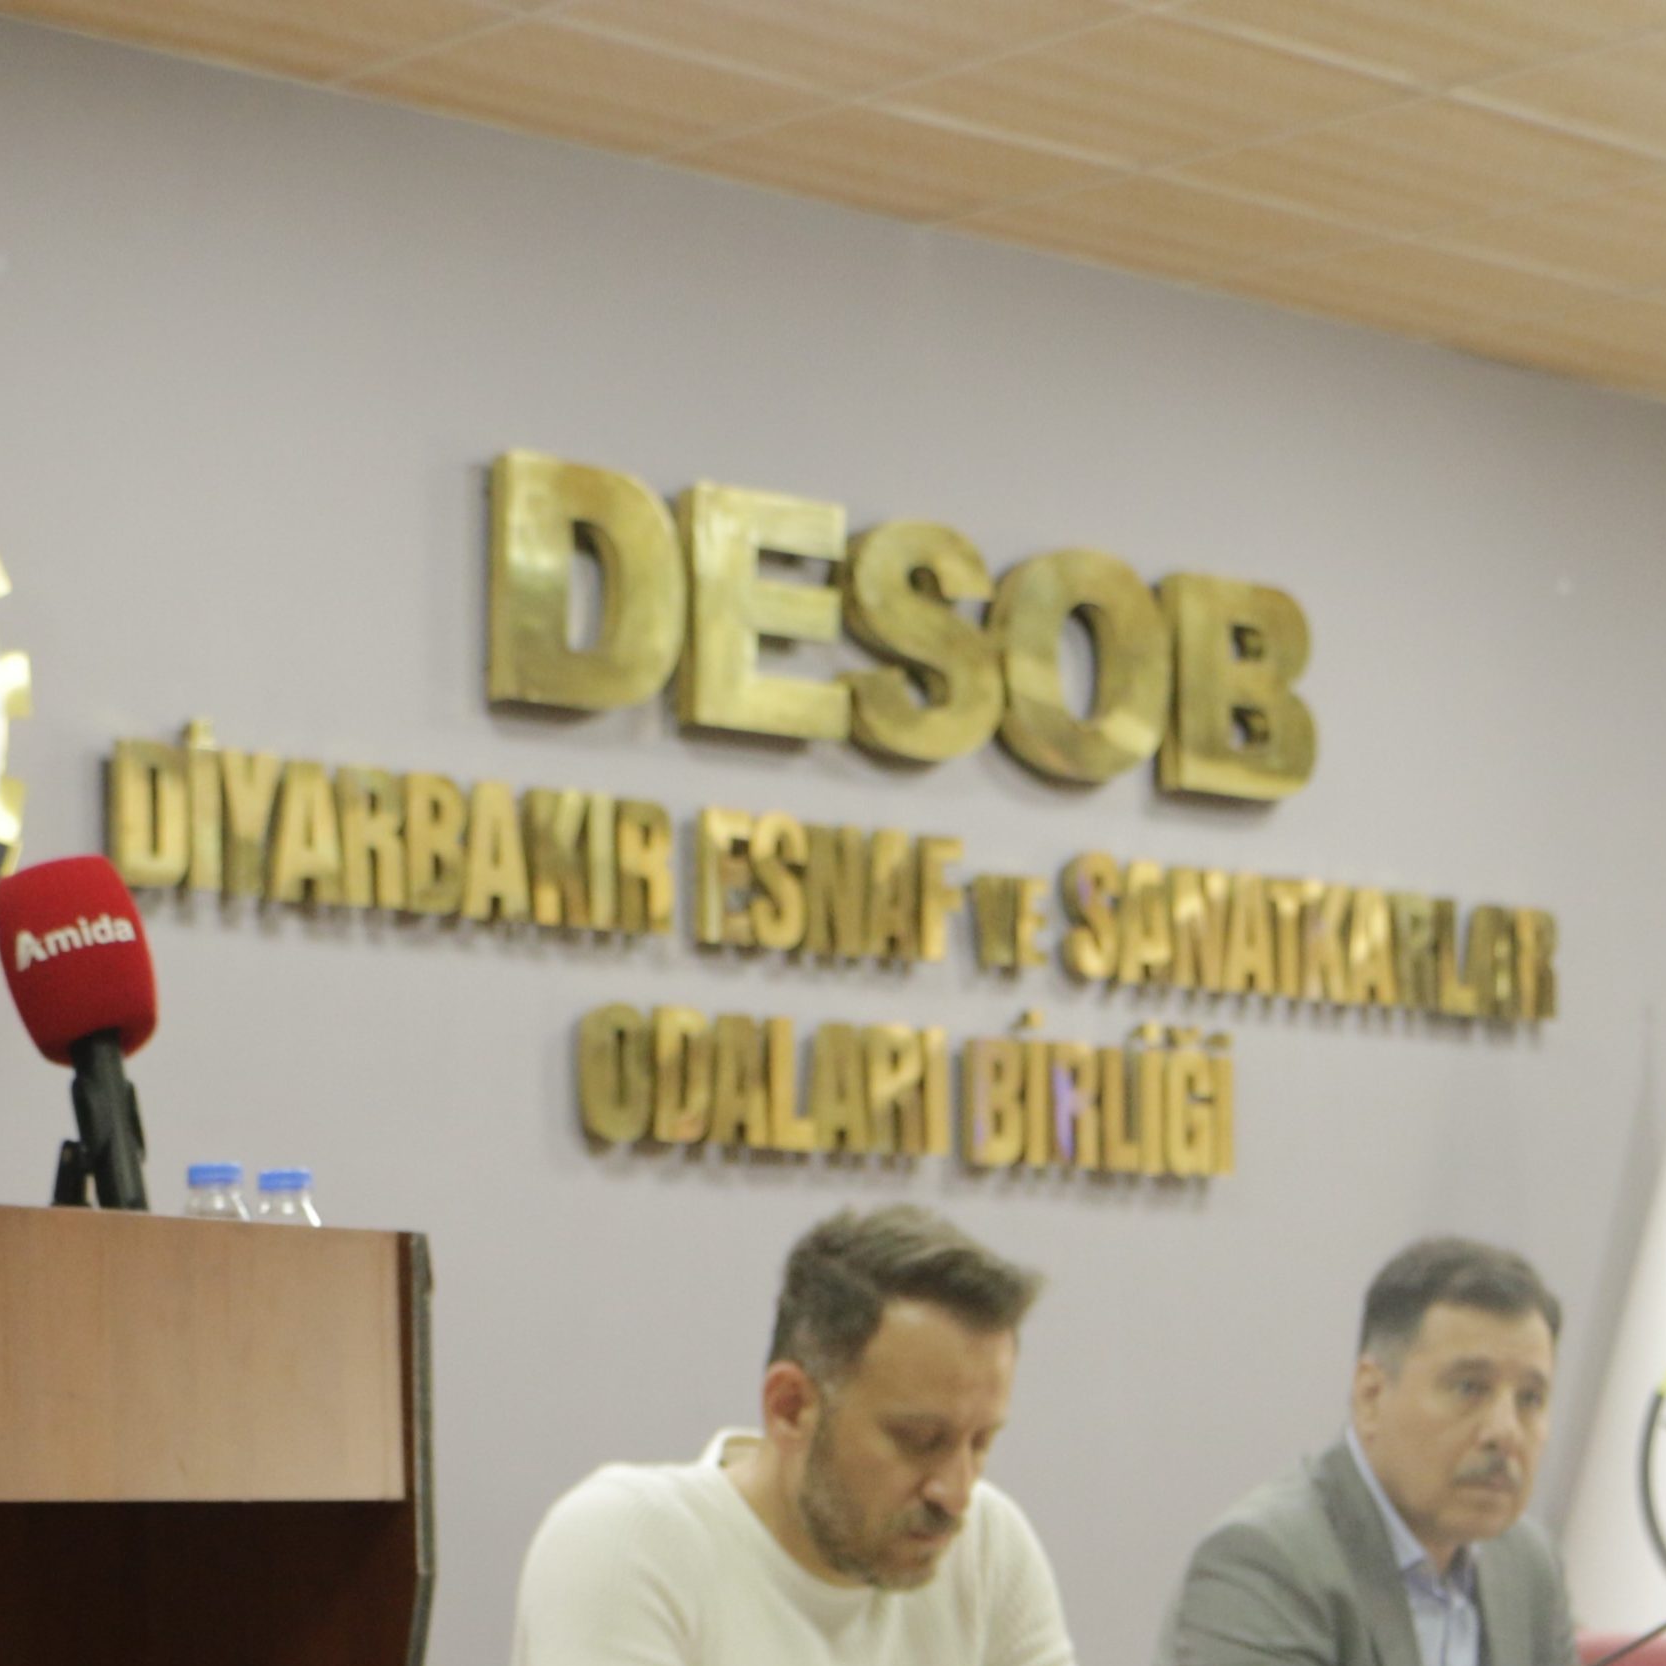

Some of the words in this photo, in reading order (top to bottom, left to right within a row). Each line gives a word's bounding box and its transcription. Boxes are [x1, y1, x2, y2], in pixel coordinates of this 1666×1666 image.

[487, 448, 1319, 801] DESOB
[14, 912, 137, 974] Amida
[113, 718, 674, 936] DİYARBAKIR
[696, 806, 964, 963] ESNAF
[1062, 851, 1558, 1021] SANATKARLAR
[578, 1003, 948, 1157] ODALARI
[964, 989, 1236, 1177] BİRLİĞİ
